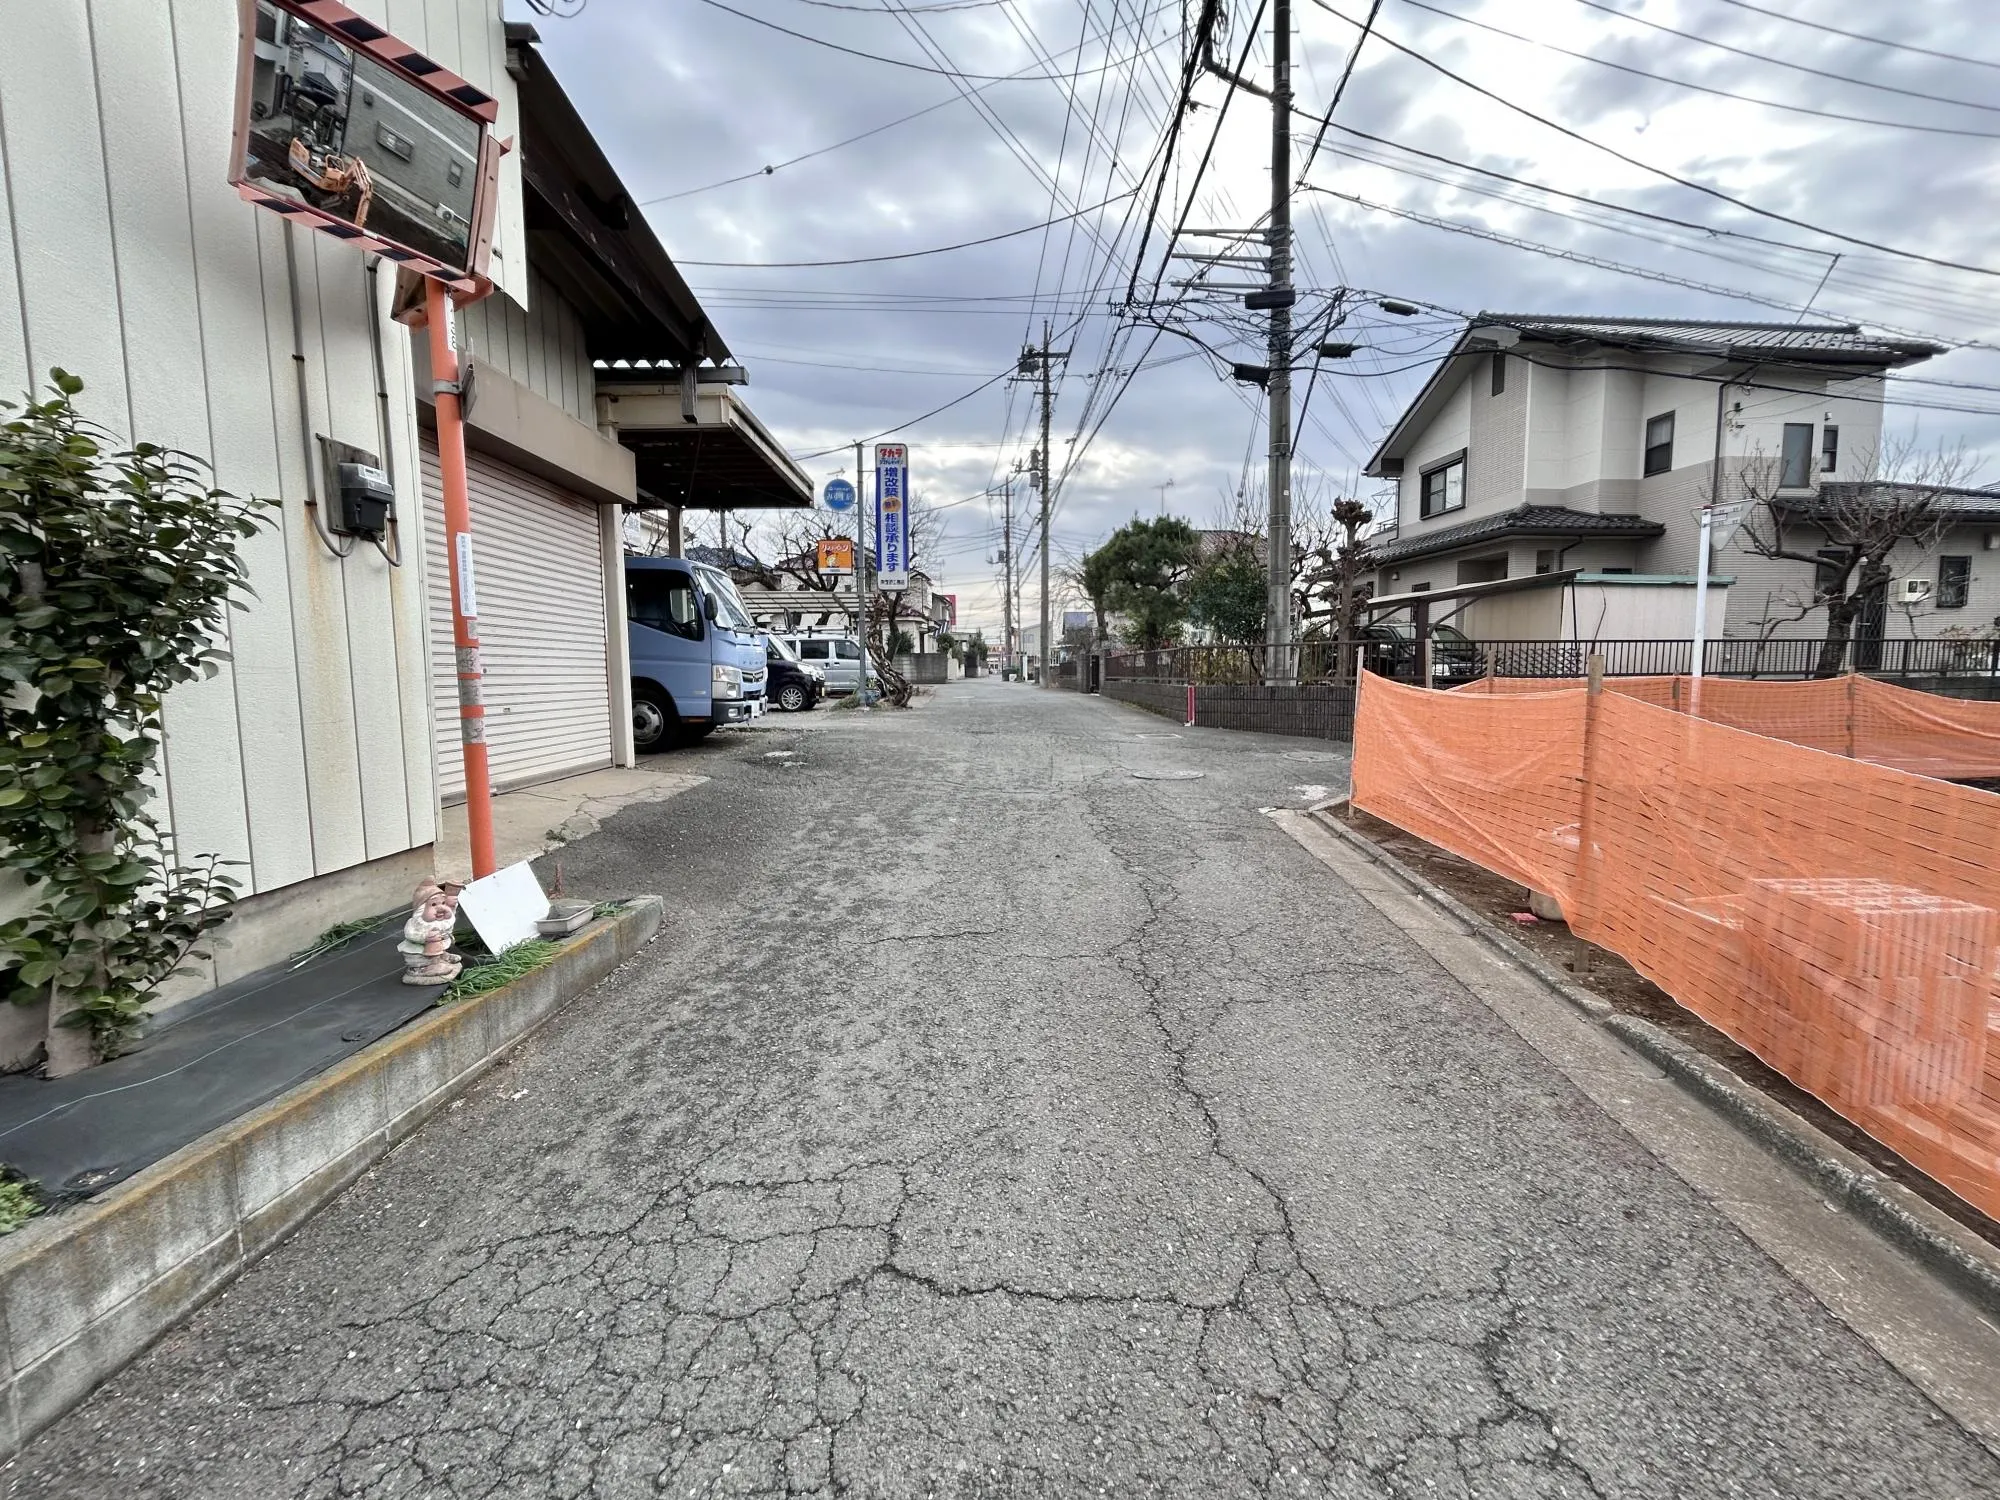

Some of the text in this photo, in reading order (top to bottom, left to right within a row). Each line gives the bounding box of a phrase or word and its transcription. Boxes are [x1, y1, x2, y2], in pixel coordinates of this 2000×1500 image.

[879, 448, 903, 457] タカラ
[884, 467, 899, 497] 増改築
[885, 513, 899, 572] 相談承ります
